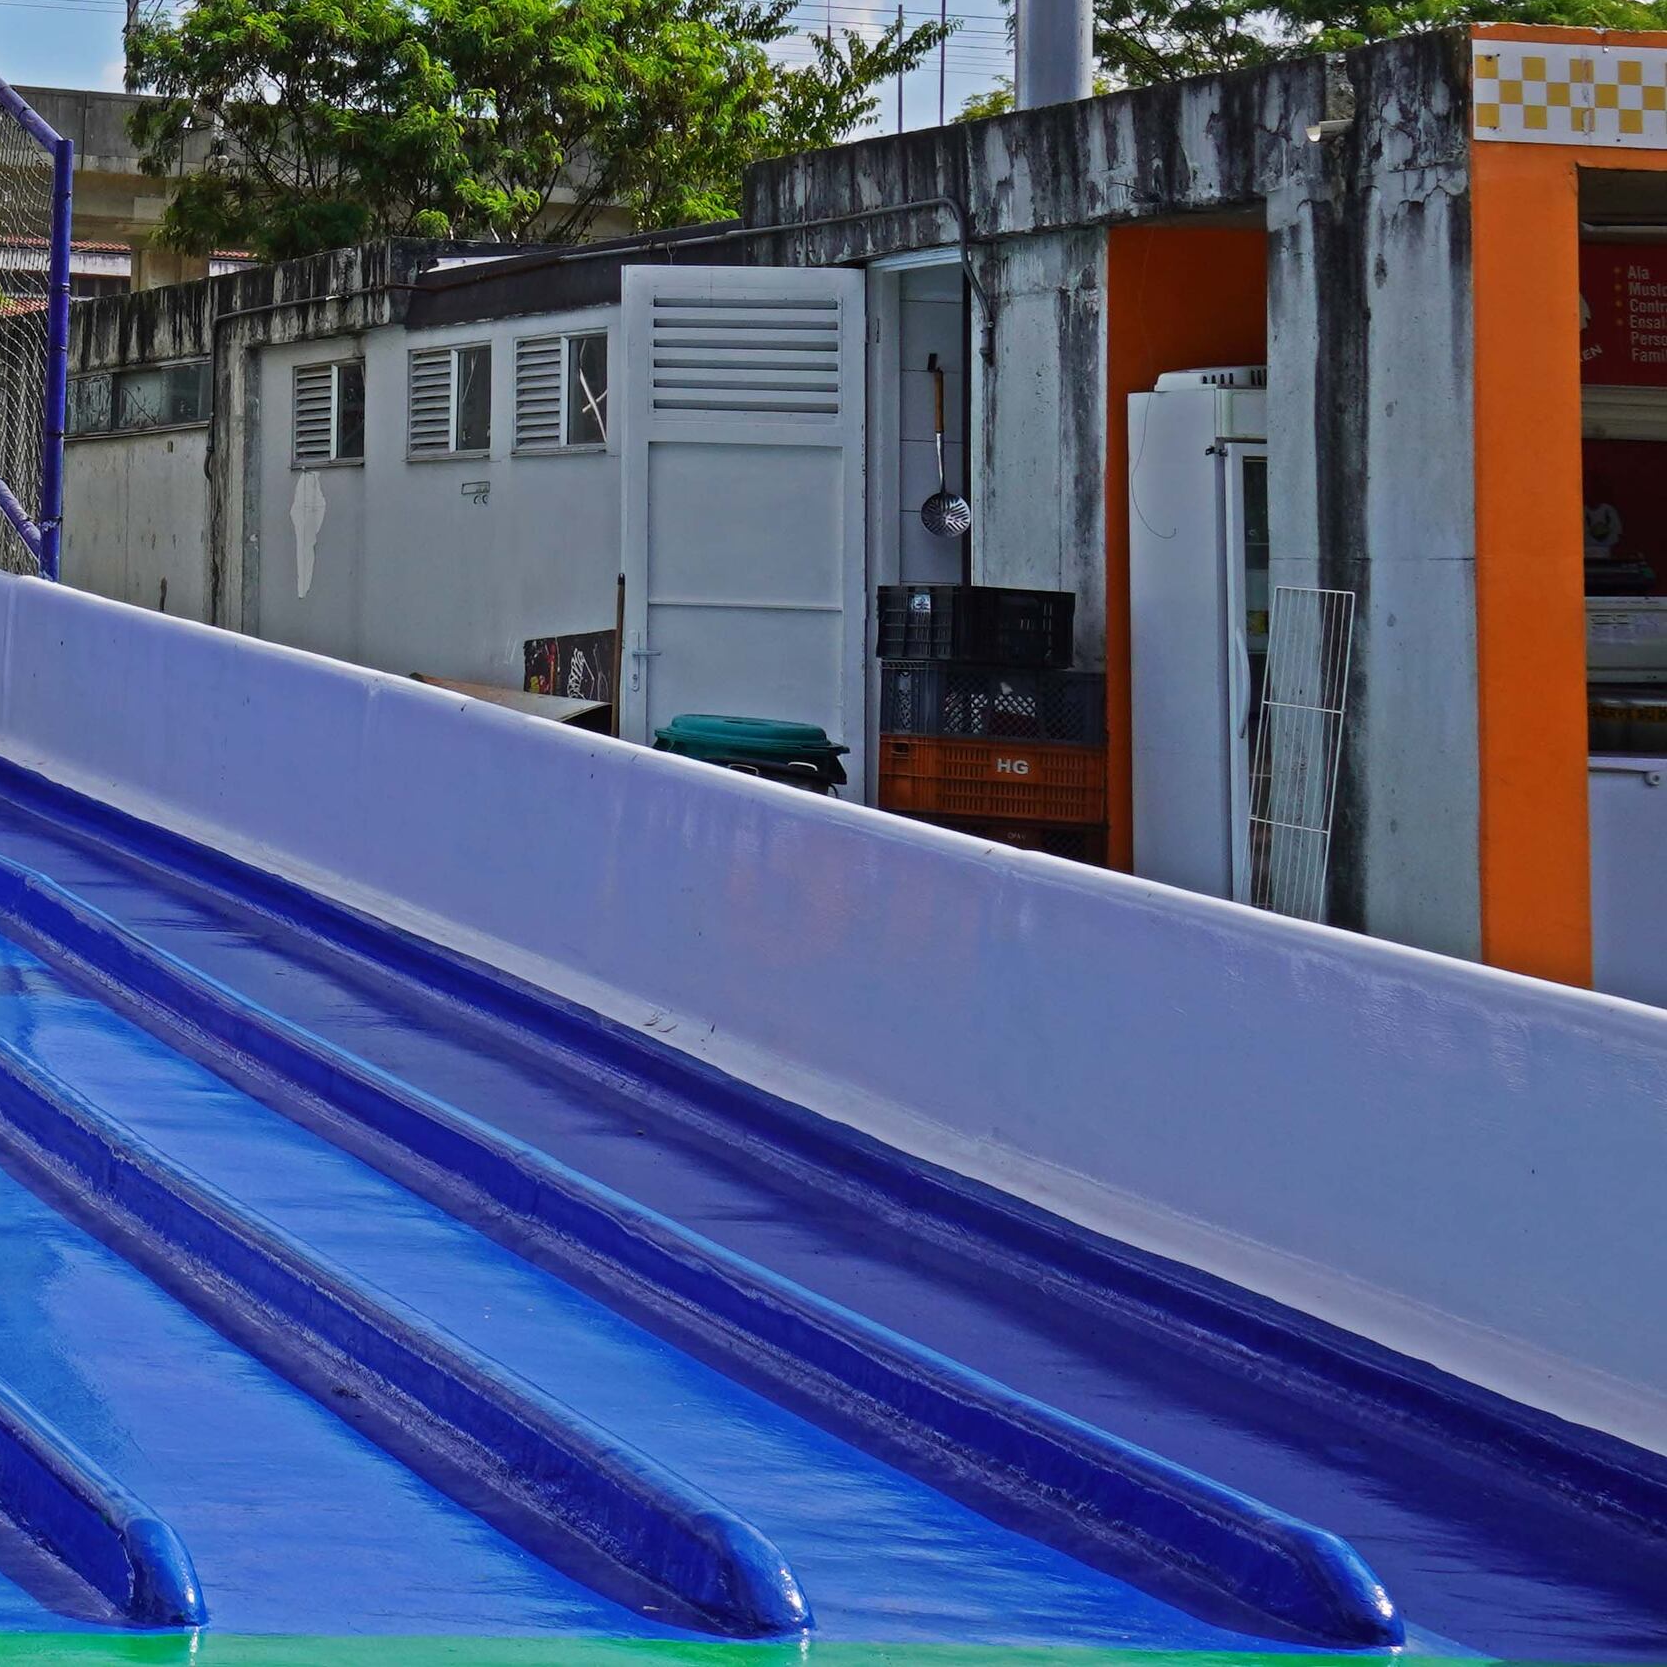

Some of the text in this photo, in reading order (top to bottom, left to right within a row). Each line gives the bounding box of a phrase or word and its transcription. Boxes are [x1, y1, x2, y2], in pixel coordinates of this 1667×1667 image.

[1627, 265, 1650, 280] Ala
[1629, 299, 1667, 313] Contr
[1629, 315, 1667, 329] Ensal
[1580, 345, 1603, 363] EN
[996, 758, 1030, 775] HG
